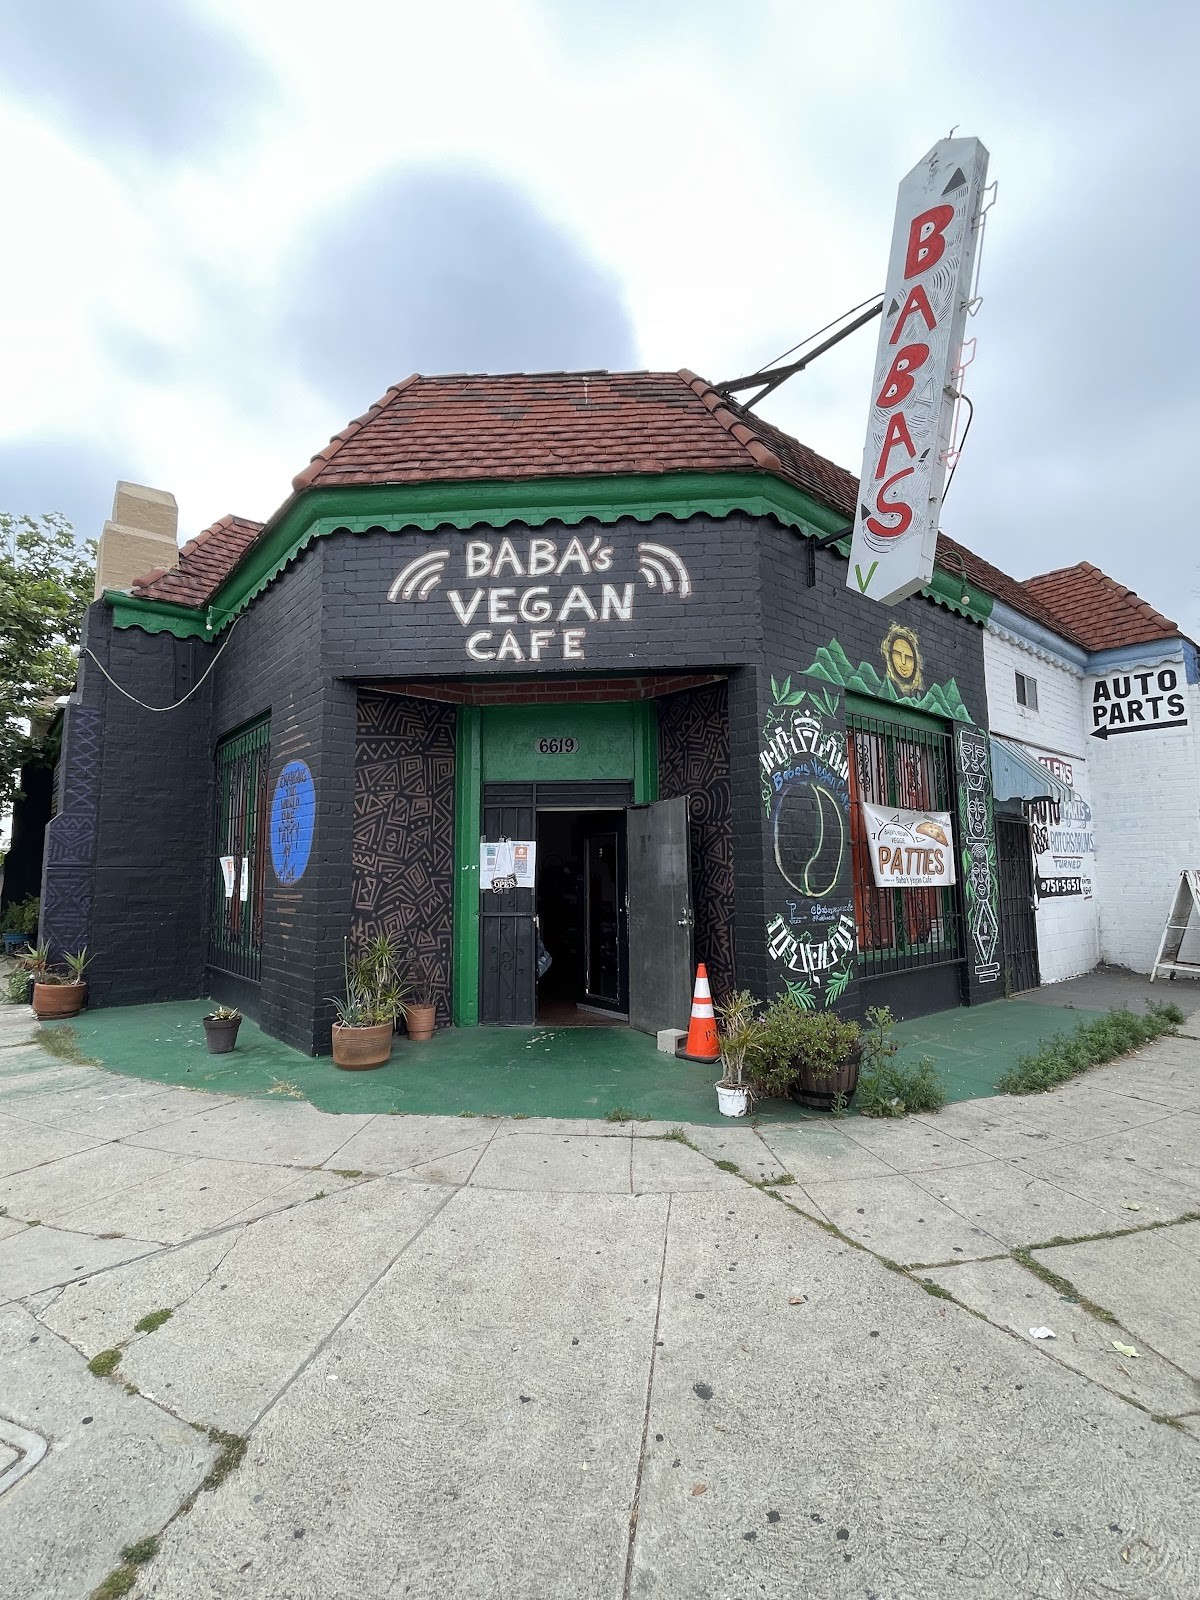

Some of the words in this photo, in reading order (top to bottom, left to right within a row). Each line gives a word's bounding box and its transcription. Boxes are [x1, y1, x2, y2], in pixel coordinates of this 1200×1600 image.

[867, 205, 954, 538] BABAS
[447, 583, 634, 626] VEGAN
[465, 628, 586, 661] CAFE
[1093, 669, 1177, 703] AUTO
[1093, 693, 1185, 727] PARTS
[538, 737, 575, 754] 6619
[879, 847, 945, 876] PATTIES
[1054, 860, 1082, 870] TURNED
[494, 879, 516, 888] OPEN
